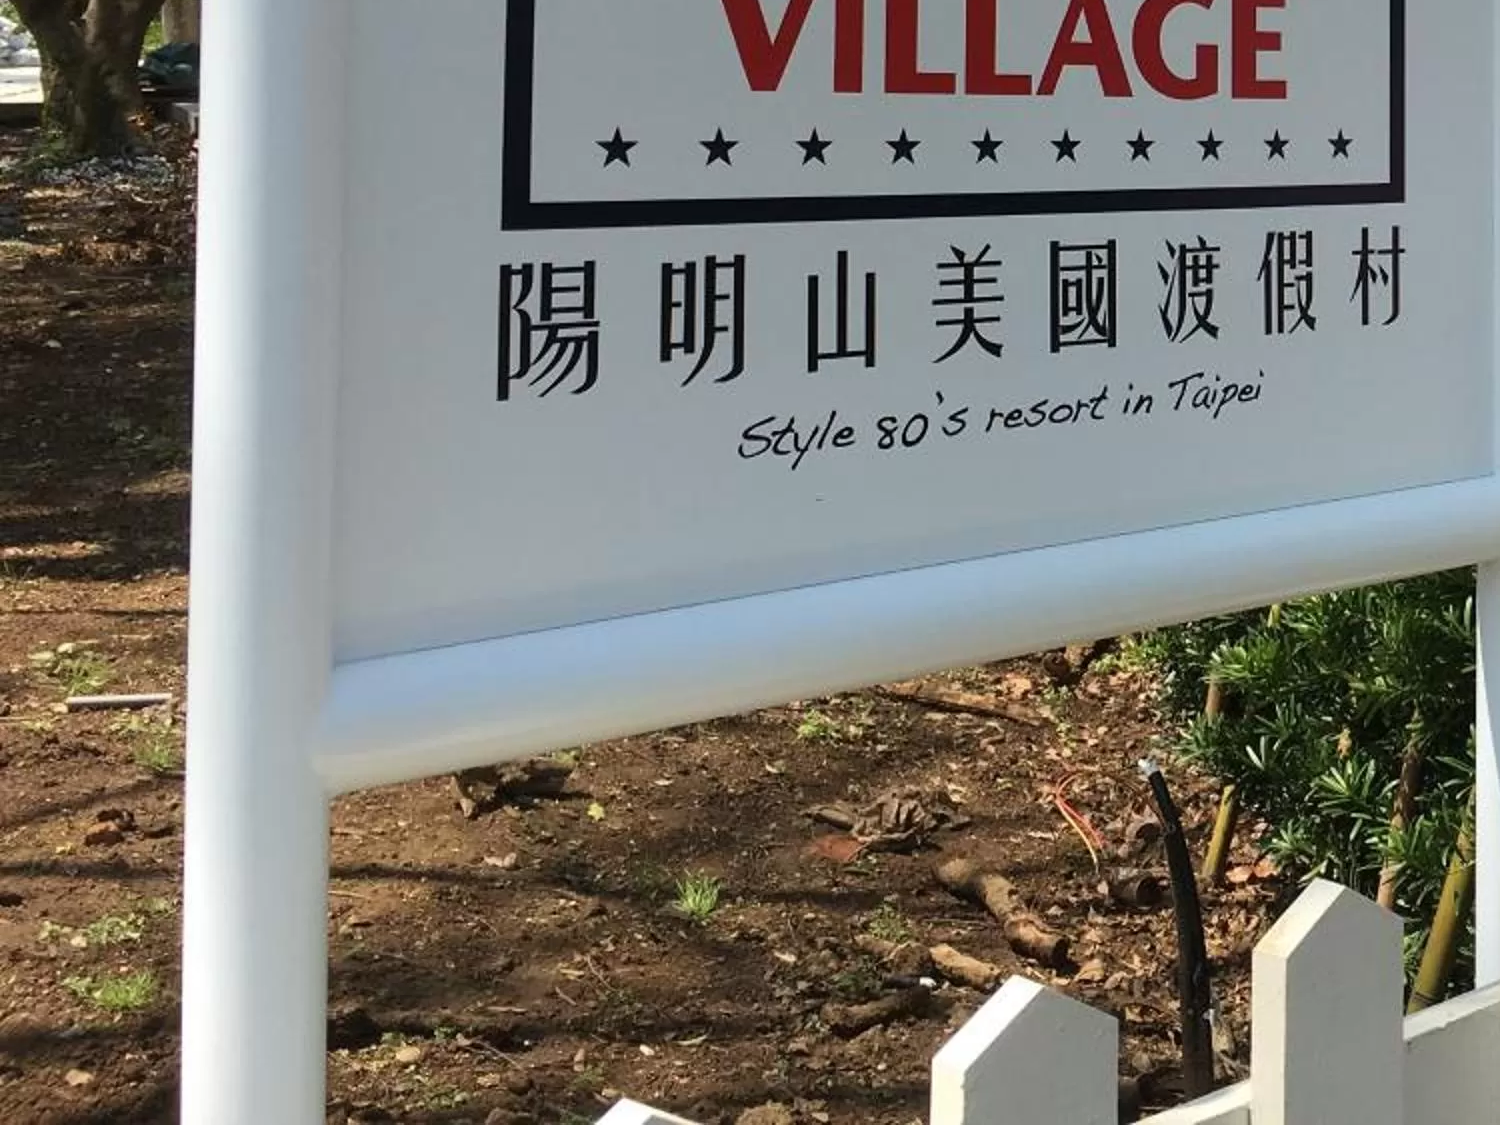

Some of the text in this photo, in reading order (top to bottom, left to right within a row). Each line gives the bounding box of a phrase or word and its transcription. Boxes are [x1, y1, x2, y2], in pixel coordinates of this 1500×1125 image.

[496, 225, 1406, 402] 陽明山美國渡假村
[737, 370, 1265, 471] Style 80's resort in Taipei
